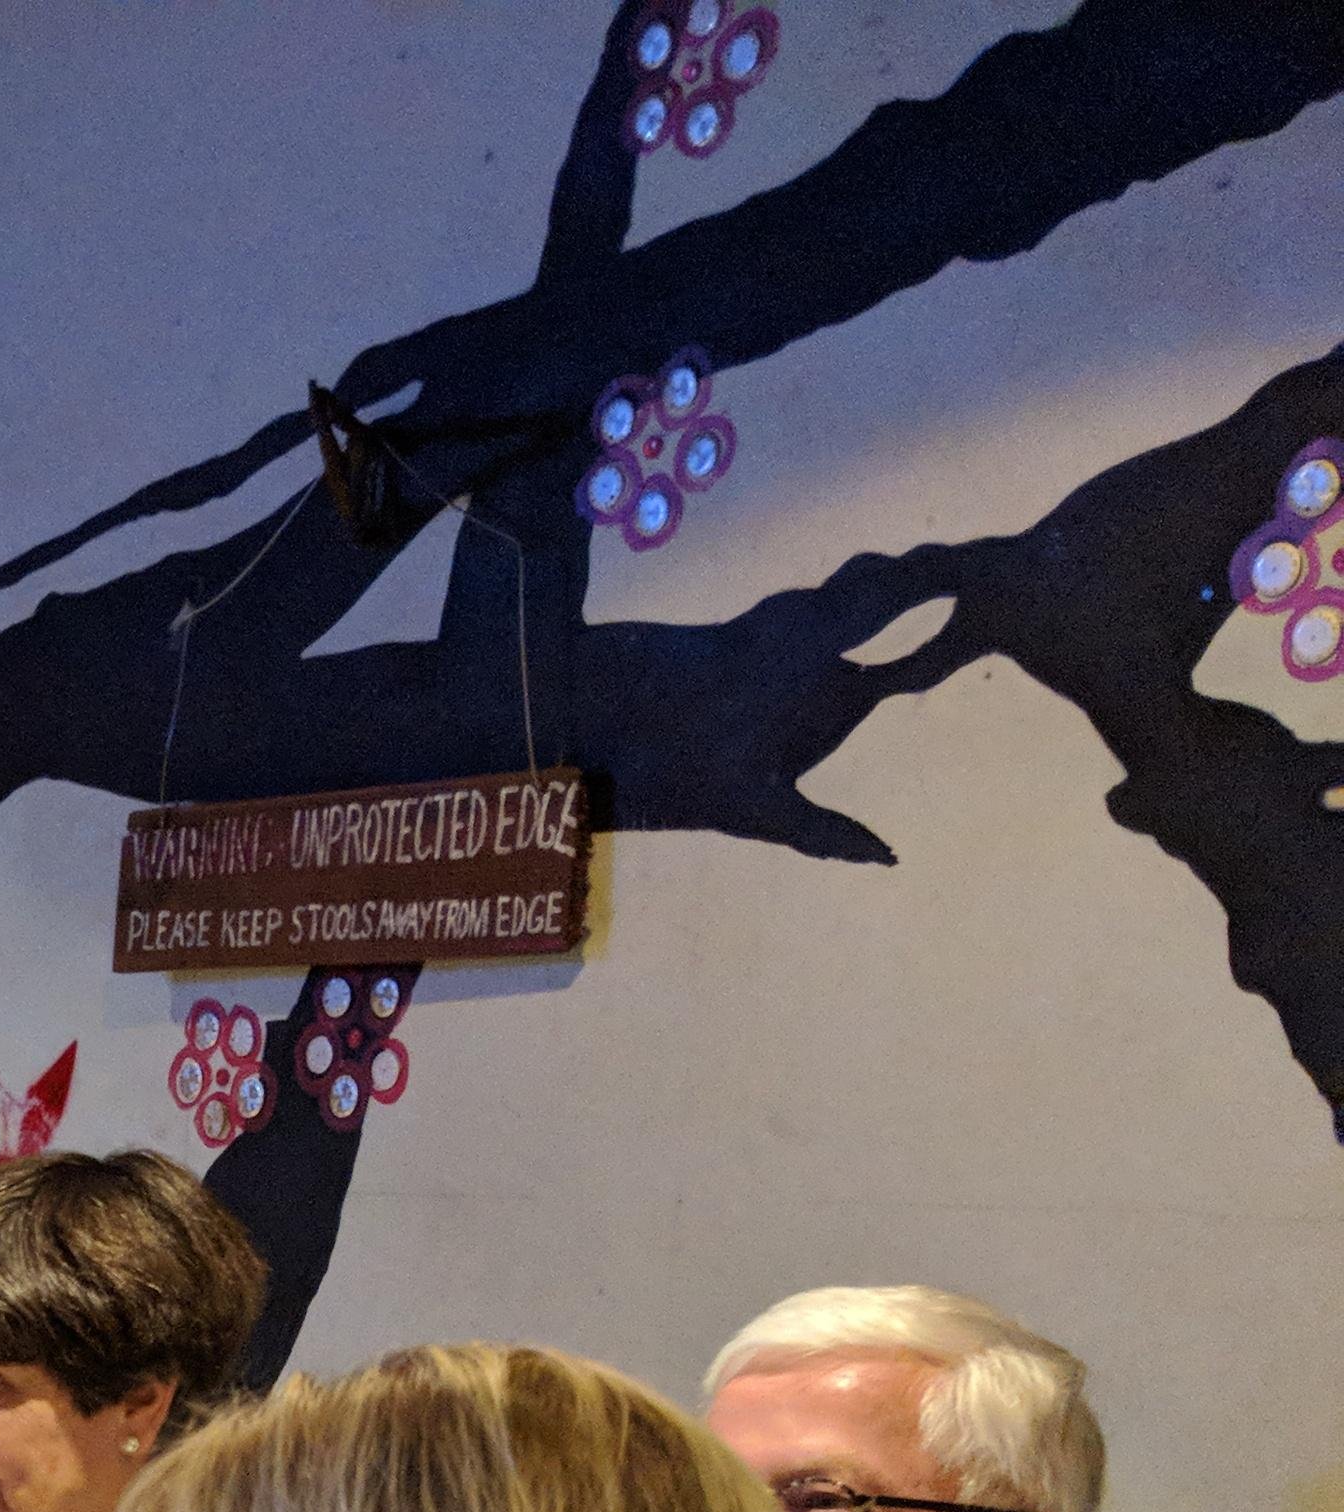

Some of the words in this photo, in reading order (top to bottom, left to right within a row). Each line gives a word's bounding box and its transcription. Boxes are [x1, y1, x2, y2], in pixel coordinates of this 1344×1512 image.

[288, 788, 488, 870] UNPROTECTED
[493, 779, 580, 861] EDGE
[126, 907, 213, 954] PLEASE
[220, 906, 284, 950] KEEP
[288, 899, 376, 946] STOOLS
[379, 898, 433, 941] AWAY
[433, 897, 489, 940] FROM
[495, 890, 565, 938] EDGE
